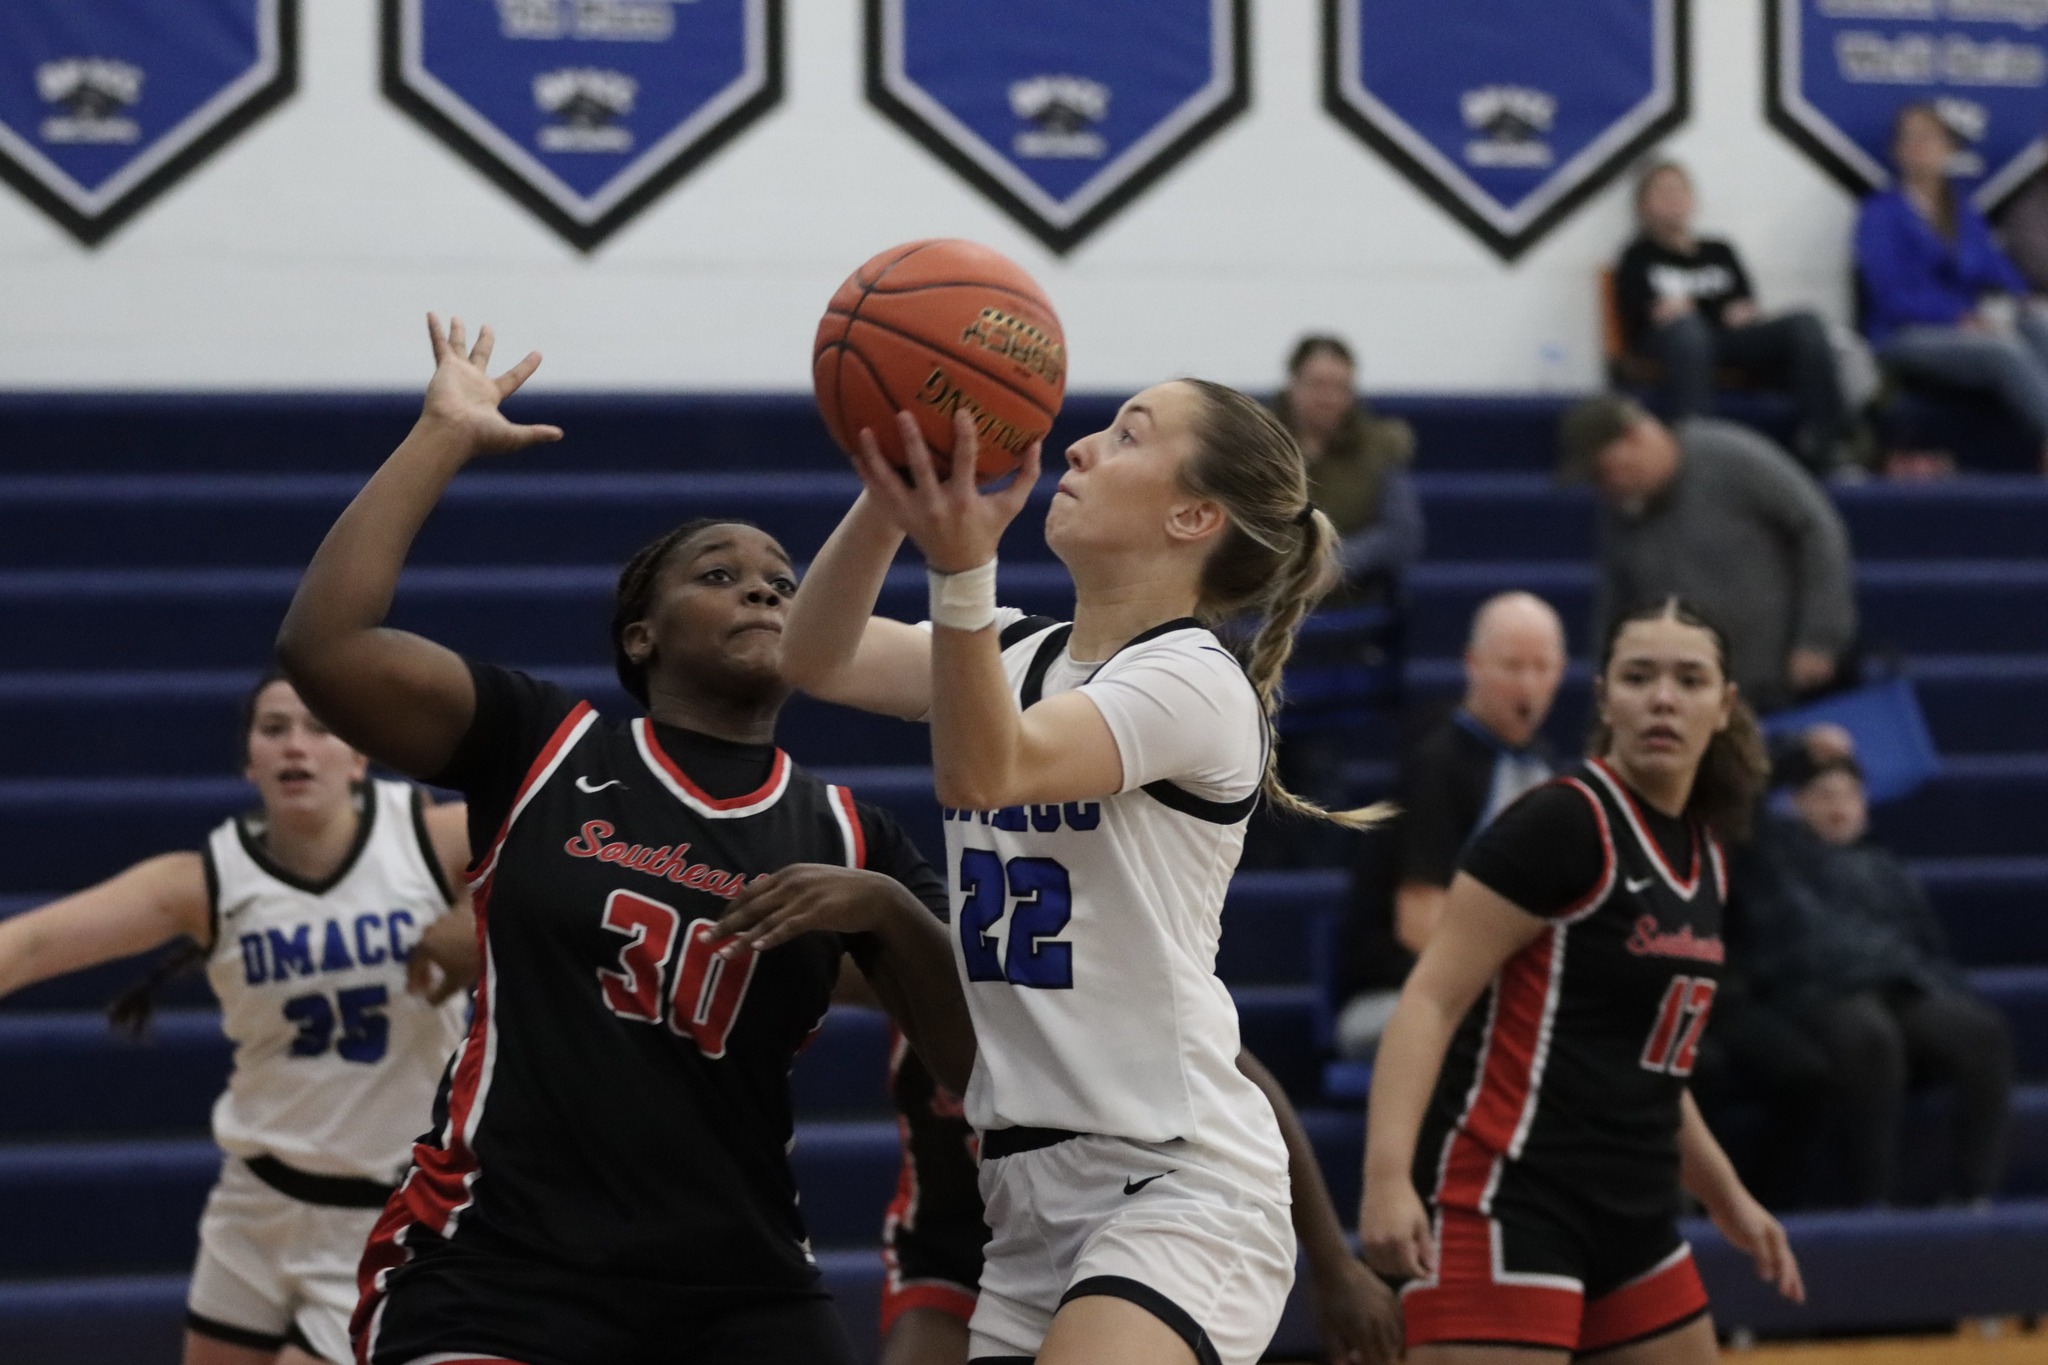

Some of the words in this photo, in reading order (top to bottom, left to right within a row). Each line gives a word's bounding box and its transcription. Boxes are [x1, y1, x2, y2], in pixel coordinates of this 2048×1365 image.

[565, 819, 770, 900] Southeas
[240, 909, 415, 985] DMACC
[960, 848, 1074, 990] 22
[597, 888, 760, 1060] 30
[283, 984, 390, 1064] 35
[1639, 974, 1718, 1077] 12
